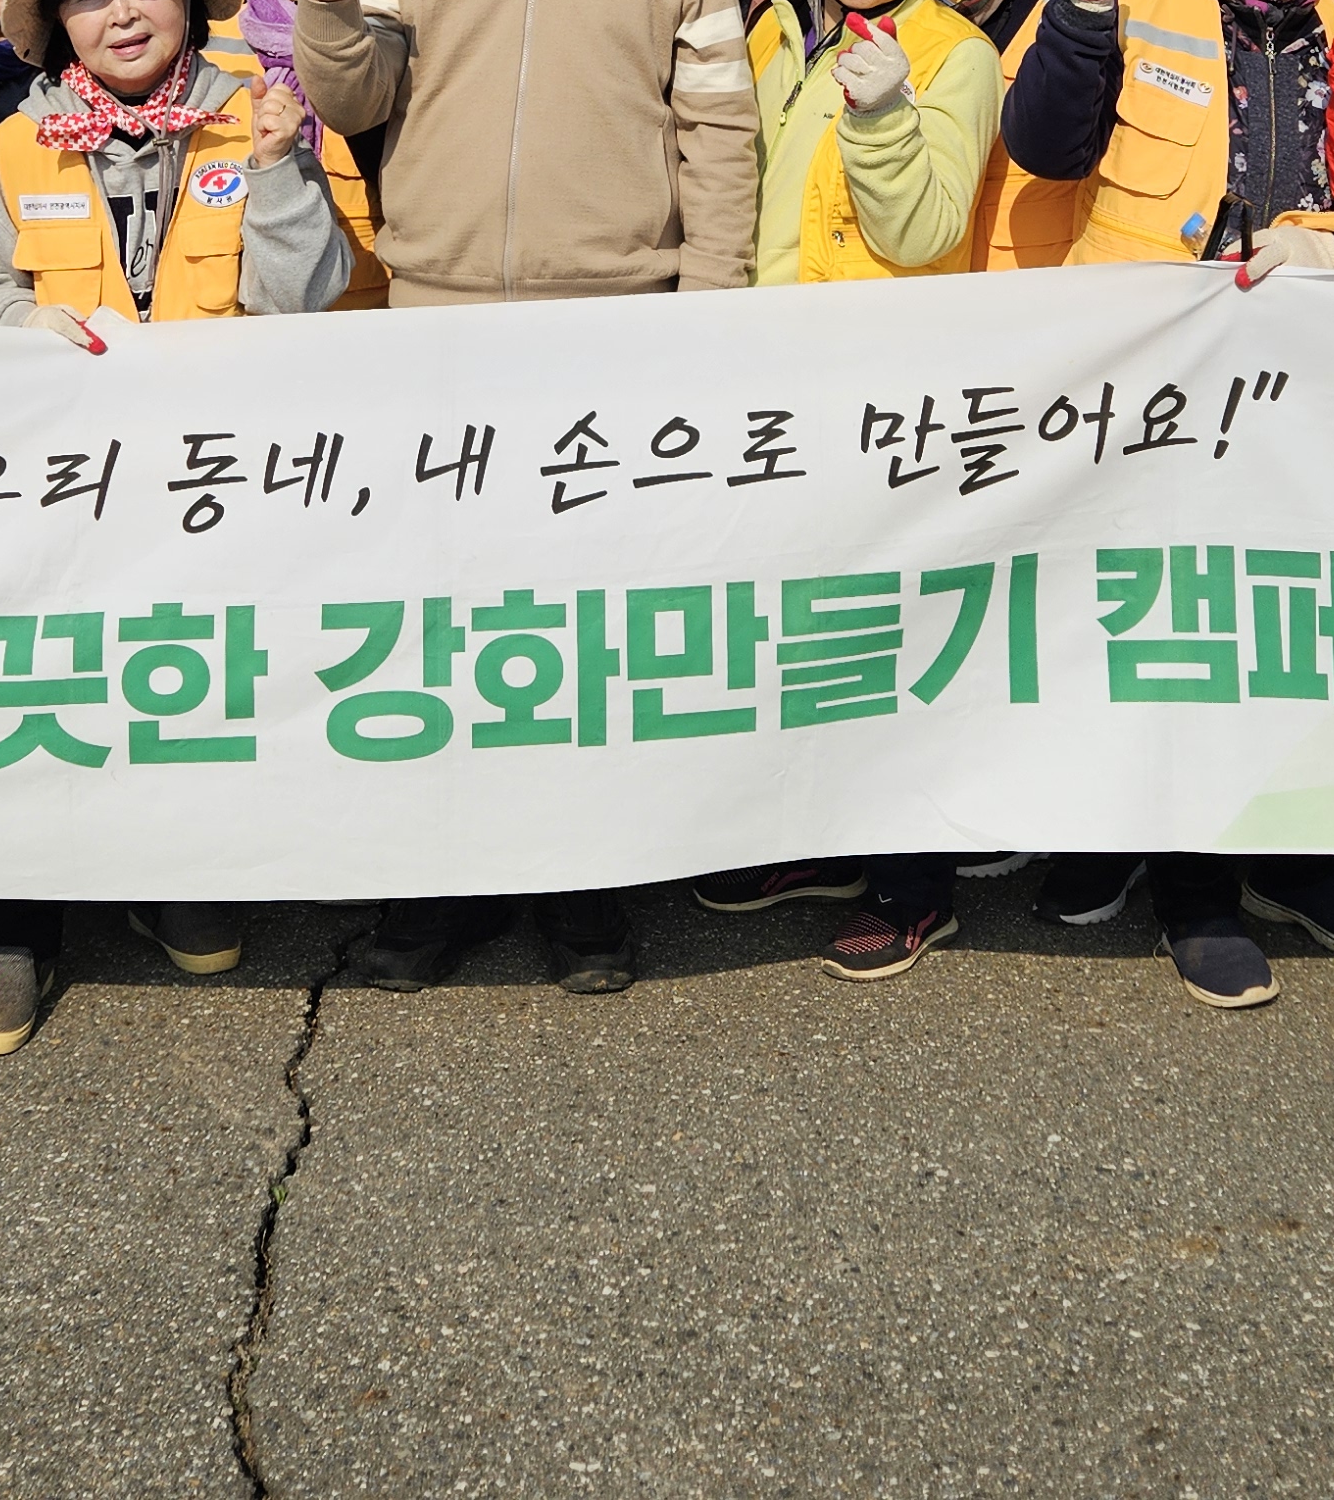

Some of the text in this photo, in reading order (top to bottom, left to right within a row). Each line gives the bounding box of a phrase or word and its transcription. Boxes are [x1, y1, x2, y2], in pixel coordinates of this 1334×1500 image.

[168, 433, 370, 534] 동네,
[415, 425, 495, 502] 내
[541, 411, 807, 515] 손으로
[861, 371, 1289, 497] 만들어요!"
[317, 552, 1039, 762] 강화만들기
